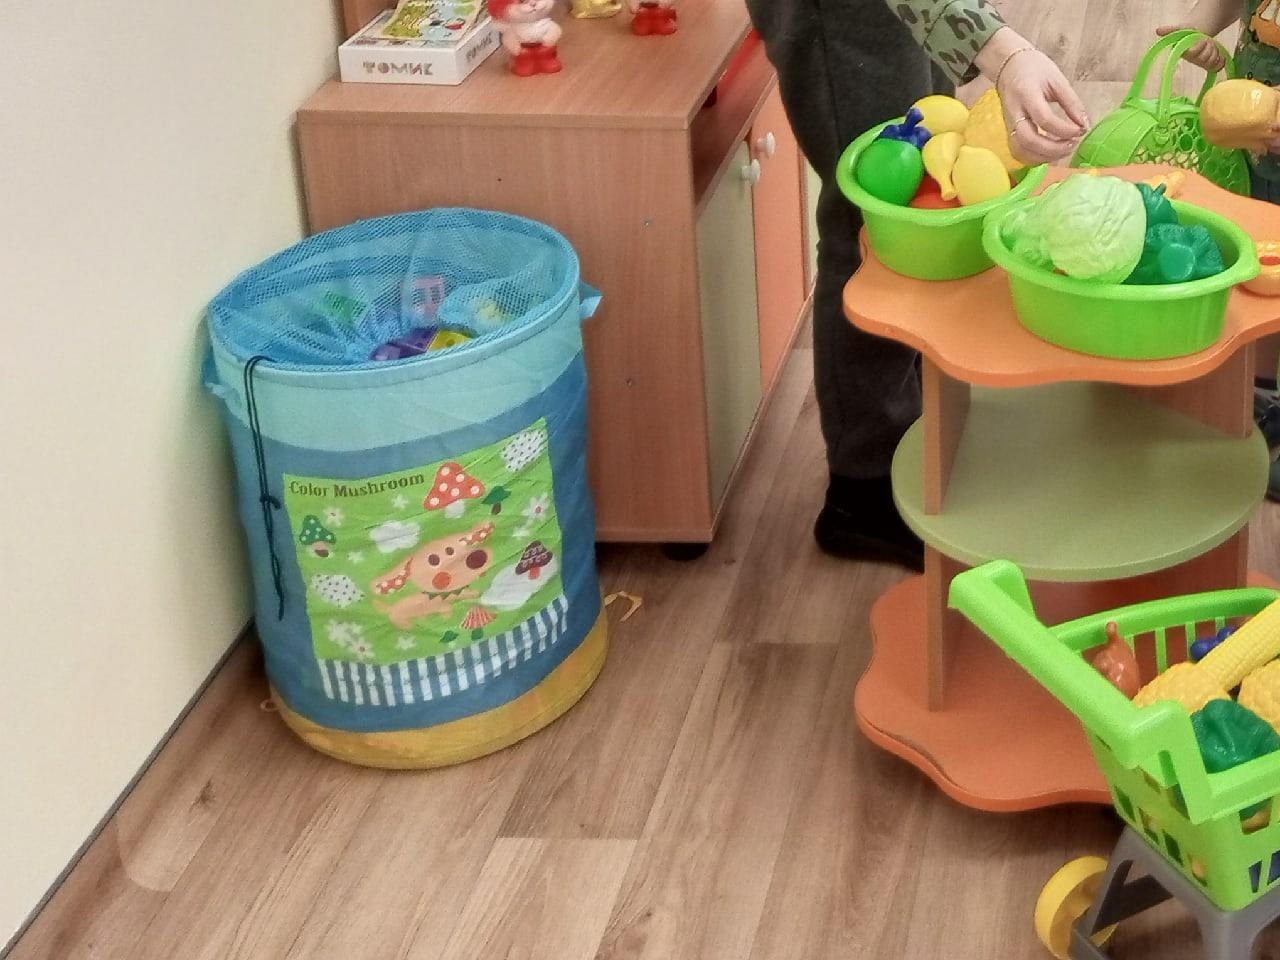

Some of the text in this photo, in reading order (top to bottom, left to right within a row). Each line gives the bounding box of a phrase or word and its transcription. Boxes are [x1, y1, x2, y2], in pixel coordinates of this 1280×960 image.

[363, 61, 433, 76] ТОМИК
[289, 473, 425, 498] Color Mushroom
